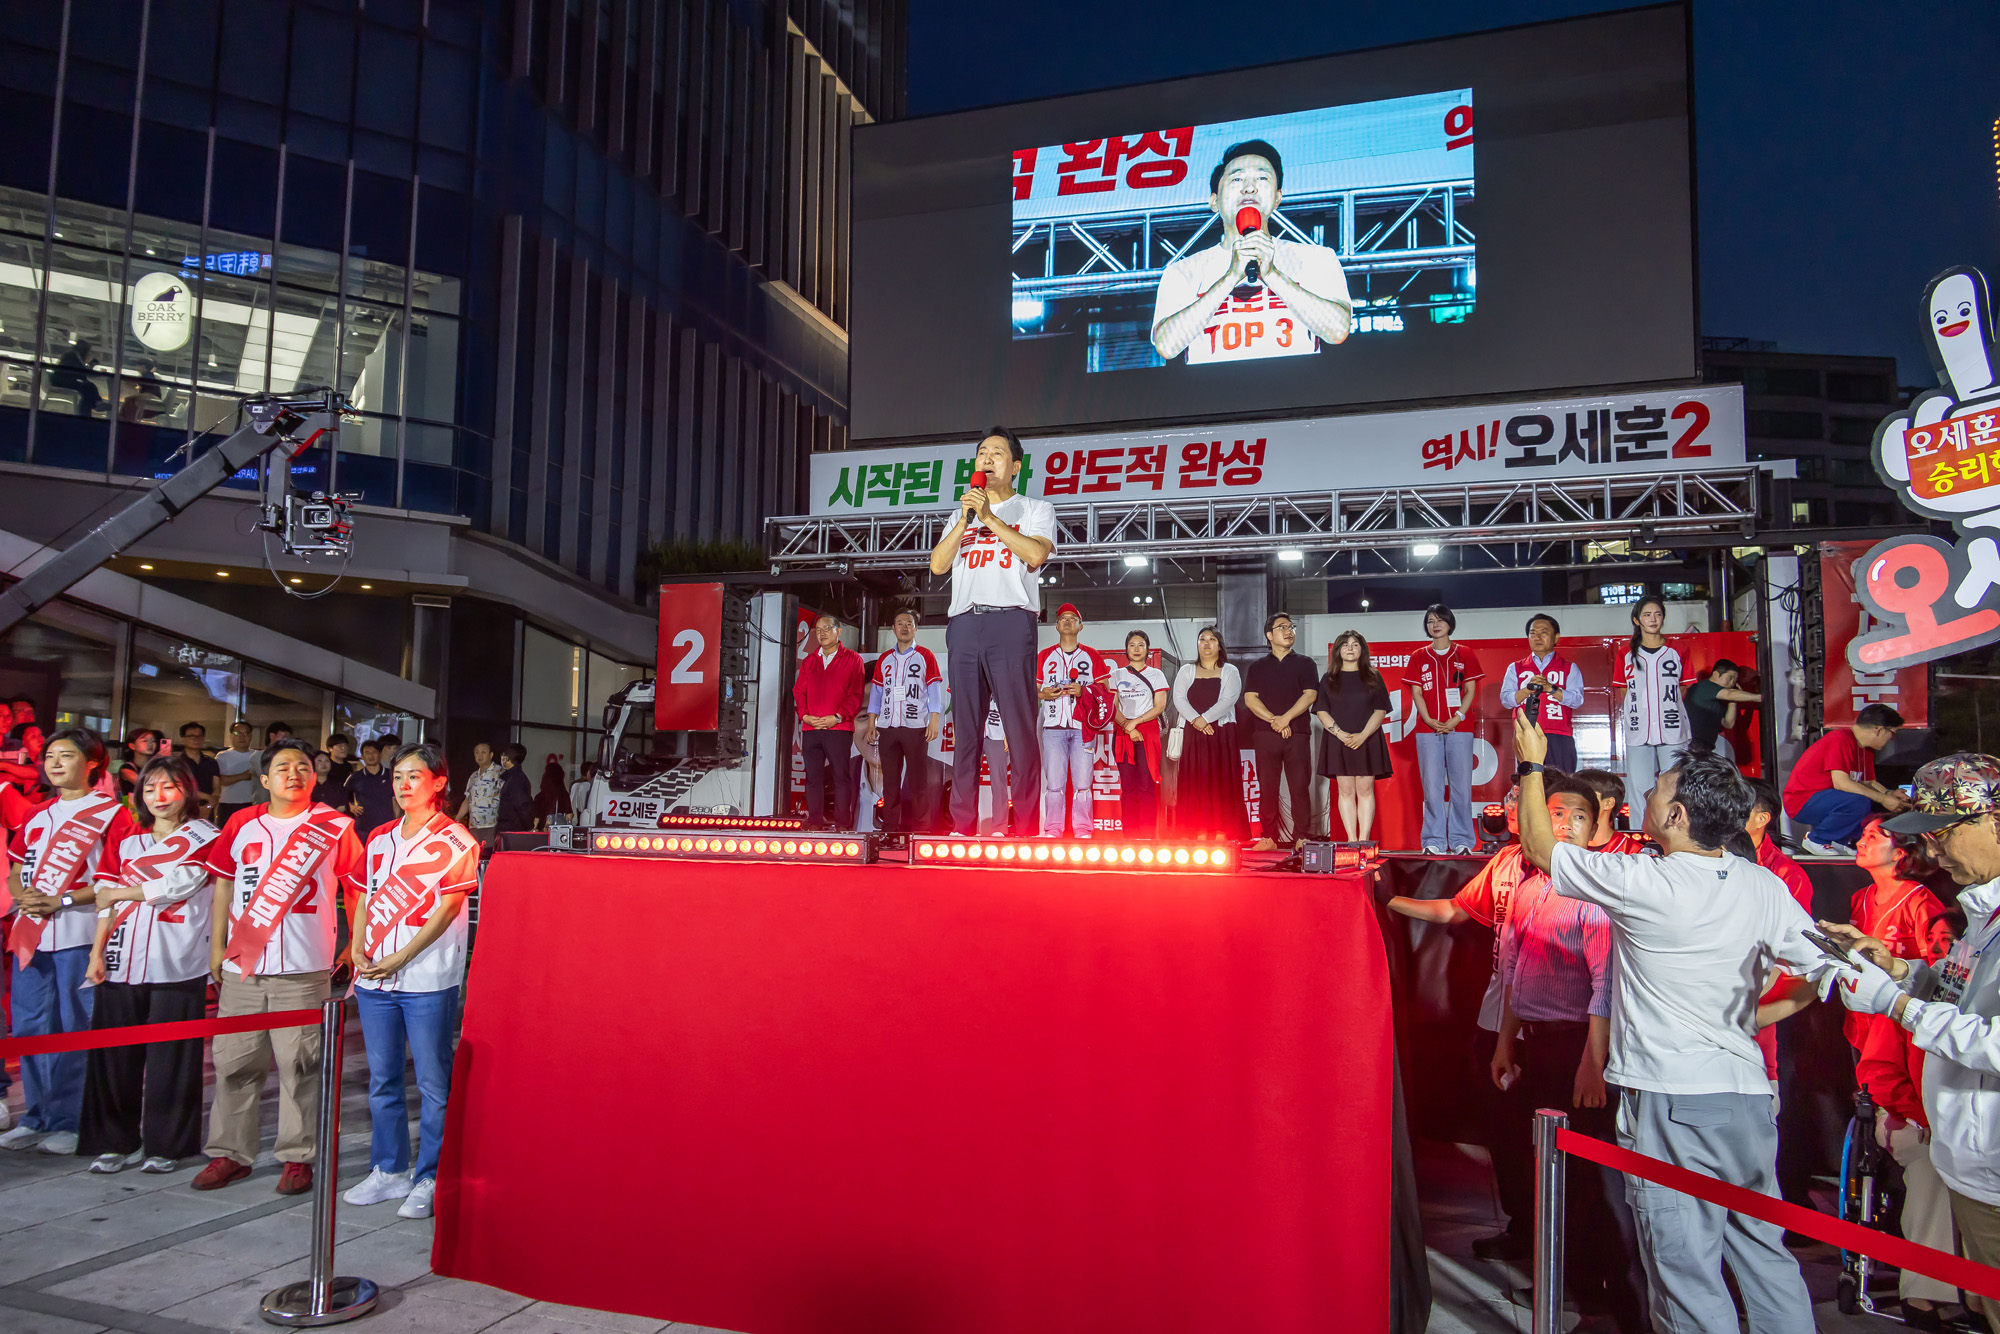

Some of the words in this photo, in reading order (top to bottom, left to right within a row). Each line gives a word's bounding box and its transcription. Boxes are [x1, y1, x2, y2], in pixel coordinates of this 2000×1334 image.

[1057, 126, 1195, 196] 완성
[137, 312, 185, 321] BERRY
[147, 303, 176, 312] OAK
[1203, 321, 1264, 355] TOP
[1275, 317, 1293, 348] 3
[1421, 420, 1501, 471] 역시!
[828, 459, 943, 509] 시작된
[1043, 443, 1169, 496] 압도적
[1179, 438, 1268, 488] 완성
[961, 550, 995, 569] TOP
[999, 548, 1012, 569] 3
[1858, 530, 2000, 666] 오
[671, 629, 705, 684] 2
[884, 664, 892, 678] 2
[1048, 661, 1057, 674] 2
[1625, 664, 1635, 680] 2
[883, 678, 892, 715] 서울시장
[906, 663, 921, 720] 오세훈
[1518, 670, 1535, 691] 2
[1661, 659, 1680, 729] 오세훈
[1628, 680, 1639, 726] 서울시장
[1093, 722, 1121, 801] 세훈
[188, 830, 206, 845] 국민의힘
[448, 834, 468, 852] 국민의힘
[35, 840, 83, 897] 손정
[132, 835, 190, 880] 2
[395, 840, 453, 897] 2
[248, 841, 322, 929] 최종부
[291, 877, 318, 914] 2
[1884, 925, 1898, 941] 2
[1838, 977, 1859, 995] 2
